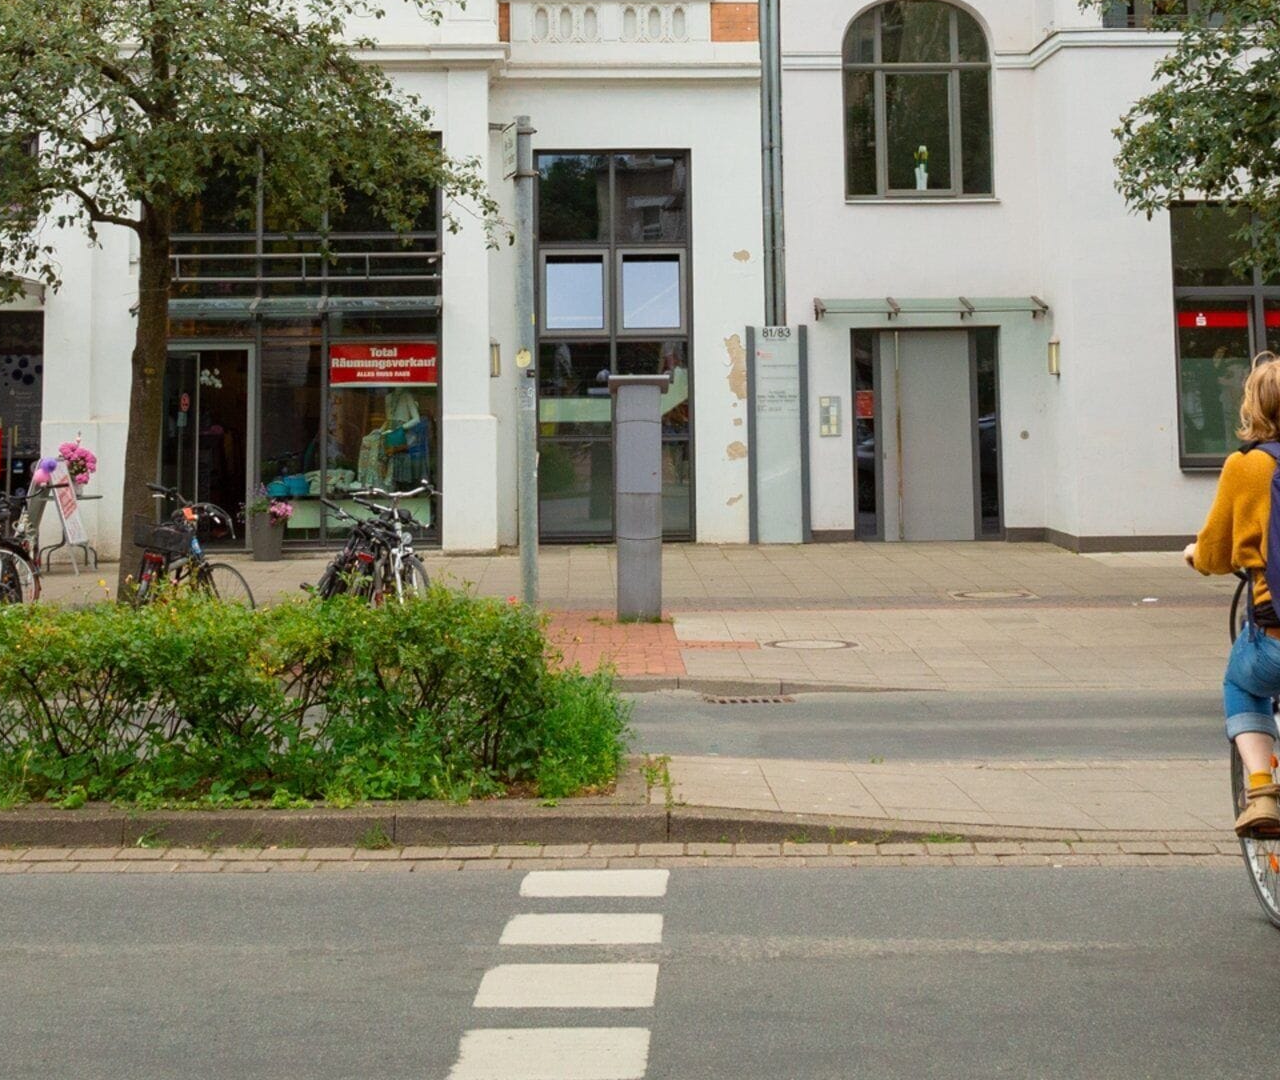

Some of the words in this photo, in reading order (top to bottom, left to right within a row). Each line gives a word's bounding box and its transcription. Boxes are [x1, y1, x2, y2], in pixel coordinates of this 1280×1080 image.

[762, 327, 792, 338] 81/83
[369, 347, 398, 358] Total
[331, 357, 437, 370] Räumungsverkauf
